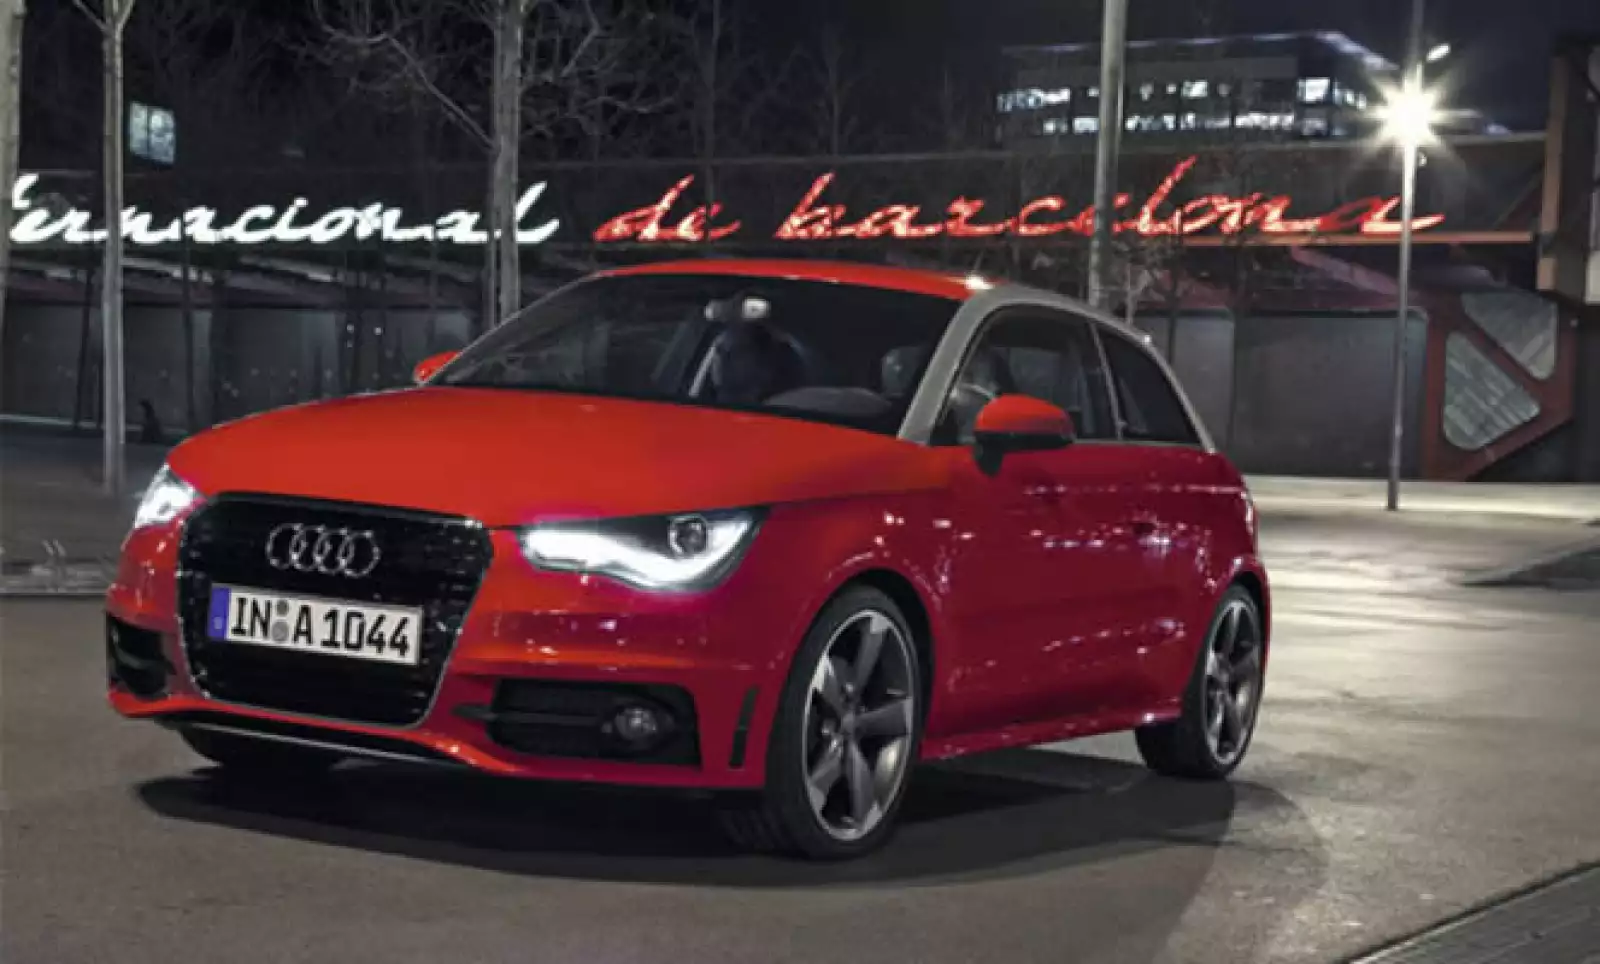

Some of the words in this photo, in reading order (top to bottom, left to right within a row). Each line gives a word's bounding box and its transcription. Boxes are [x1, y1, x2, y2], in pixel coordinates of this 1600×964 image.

[594, 174, 741, 242] de
[230, 597, 271, 638] IN
[320, 609, 410, 657] 1044
